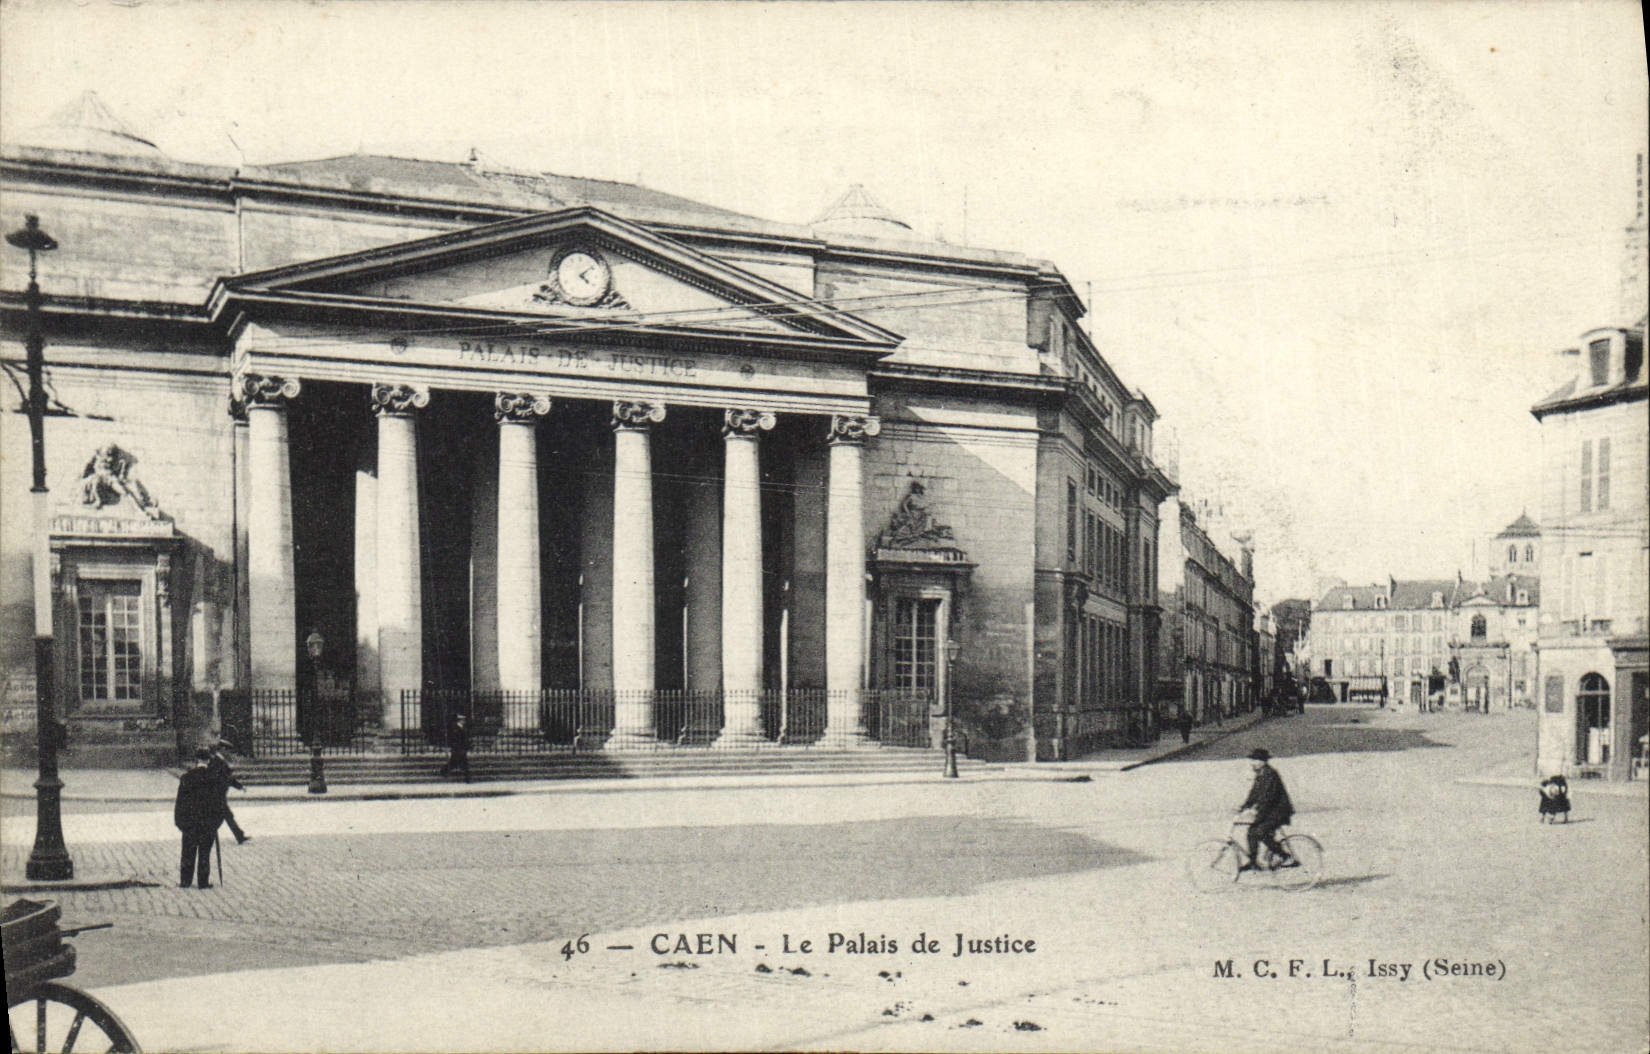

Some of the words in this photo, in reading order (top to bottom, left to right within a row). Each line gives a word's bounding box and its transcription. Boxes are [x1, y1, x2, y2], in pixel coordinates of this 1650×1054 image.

[458, 341, 540, 366] PALAIS
[557, 349, 588, 369] DE
[607, 353, 697, 378] JUSTICE
